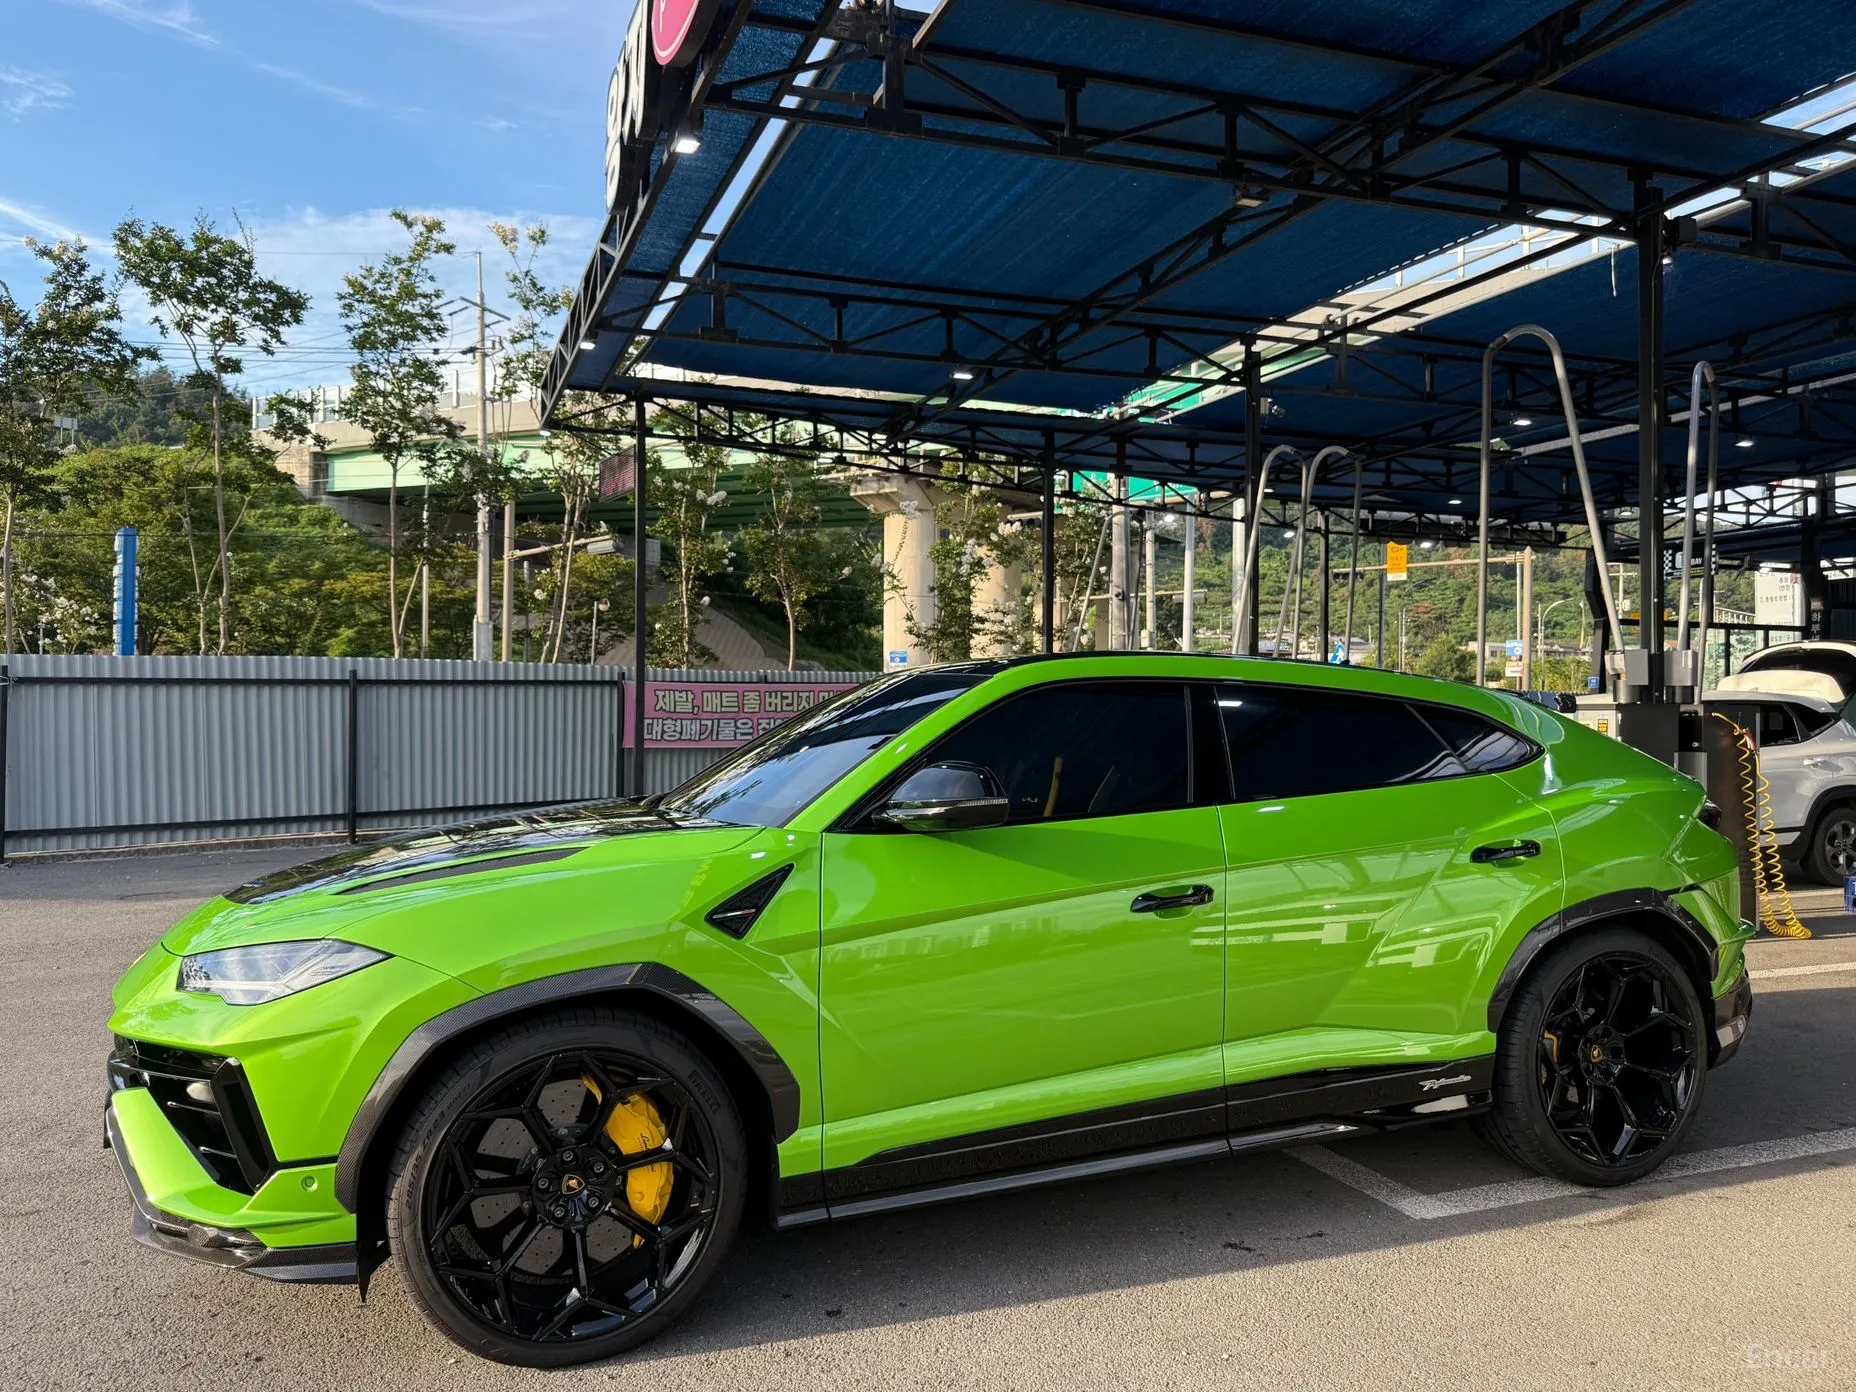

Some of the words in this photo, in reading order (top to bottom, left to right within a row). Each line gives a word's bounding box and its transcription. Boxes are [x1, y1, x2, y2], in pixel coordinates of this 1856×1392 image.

[655, 690, 699, 715] 제발,
[702, 690, 739, 713] 매트
[743, 691, 760, 713] 좀
[765, 691, 815, 713] 버리지
[644, 718, 754, 741] 대형폐기물은
